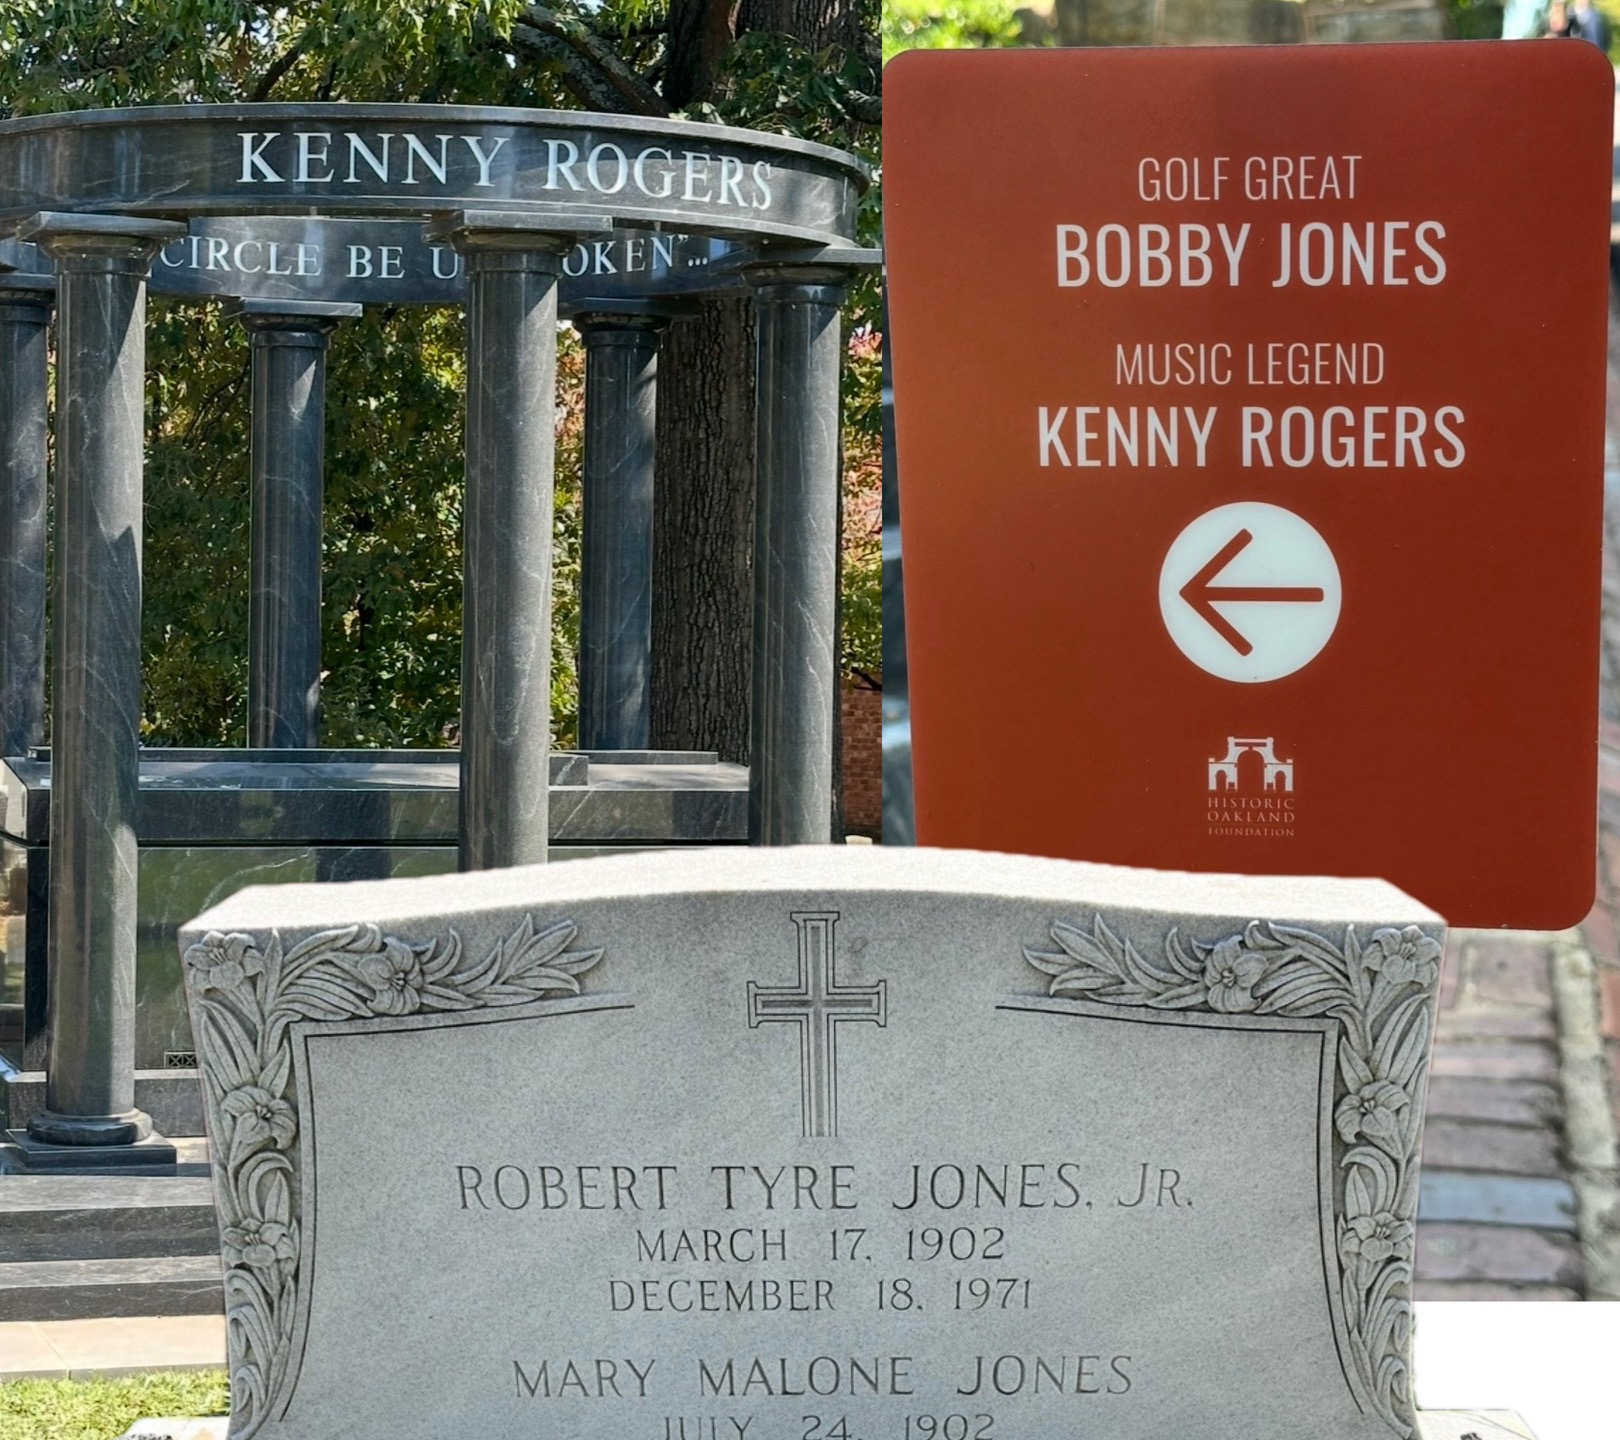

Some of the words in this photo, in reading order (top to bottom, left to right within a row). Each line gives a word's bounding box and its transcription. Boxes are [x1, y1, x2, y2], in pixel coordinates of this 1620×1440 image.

[237, 130, 510, 187] KENNY
[541, 138, 774, 210] ROGERS
[1137, 156, 1230, 201] GOLF
[1244, 155, 1362, 200] GREAT
[160, 234, 322, 277] CIRCLE
[345, 244, 404, 279] BE
[1055, 222, 1251, 288] BOBBY
[1272, 220, 1448, 287] JONES
[1115, 342, 1233, 386] MUSIC
[1247, 342, 1385, 386] LEGEND
[1037, 406, 1218, 468] KENNY
[1241, 405, 1467, 469] ROGERS
[1207, 797, 1295, 810] HISTORIC
[1207, 810, 1295, 823] OAKLAND
[1207, 826, 1295, 837] FOUNDATION
[456, 1164, 678, 1211] ROBERT
[710, 1164, 860, 1210] TYRE
[891, 1162, 1094, 1211] JONES,
[636, 1228, 788, 1262] MARCH
[905, 1226, 1006, 1261] 1902
[609, 1280, 836, 1313] DECEMBER
[953, 1278, 1032, 1311] 1971
[512, 1358, 657, 1399] MARY
[698, 1356, 915, 1397] MALONE
[955, 1355, 1134, 1396] JONES
